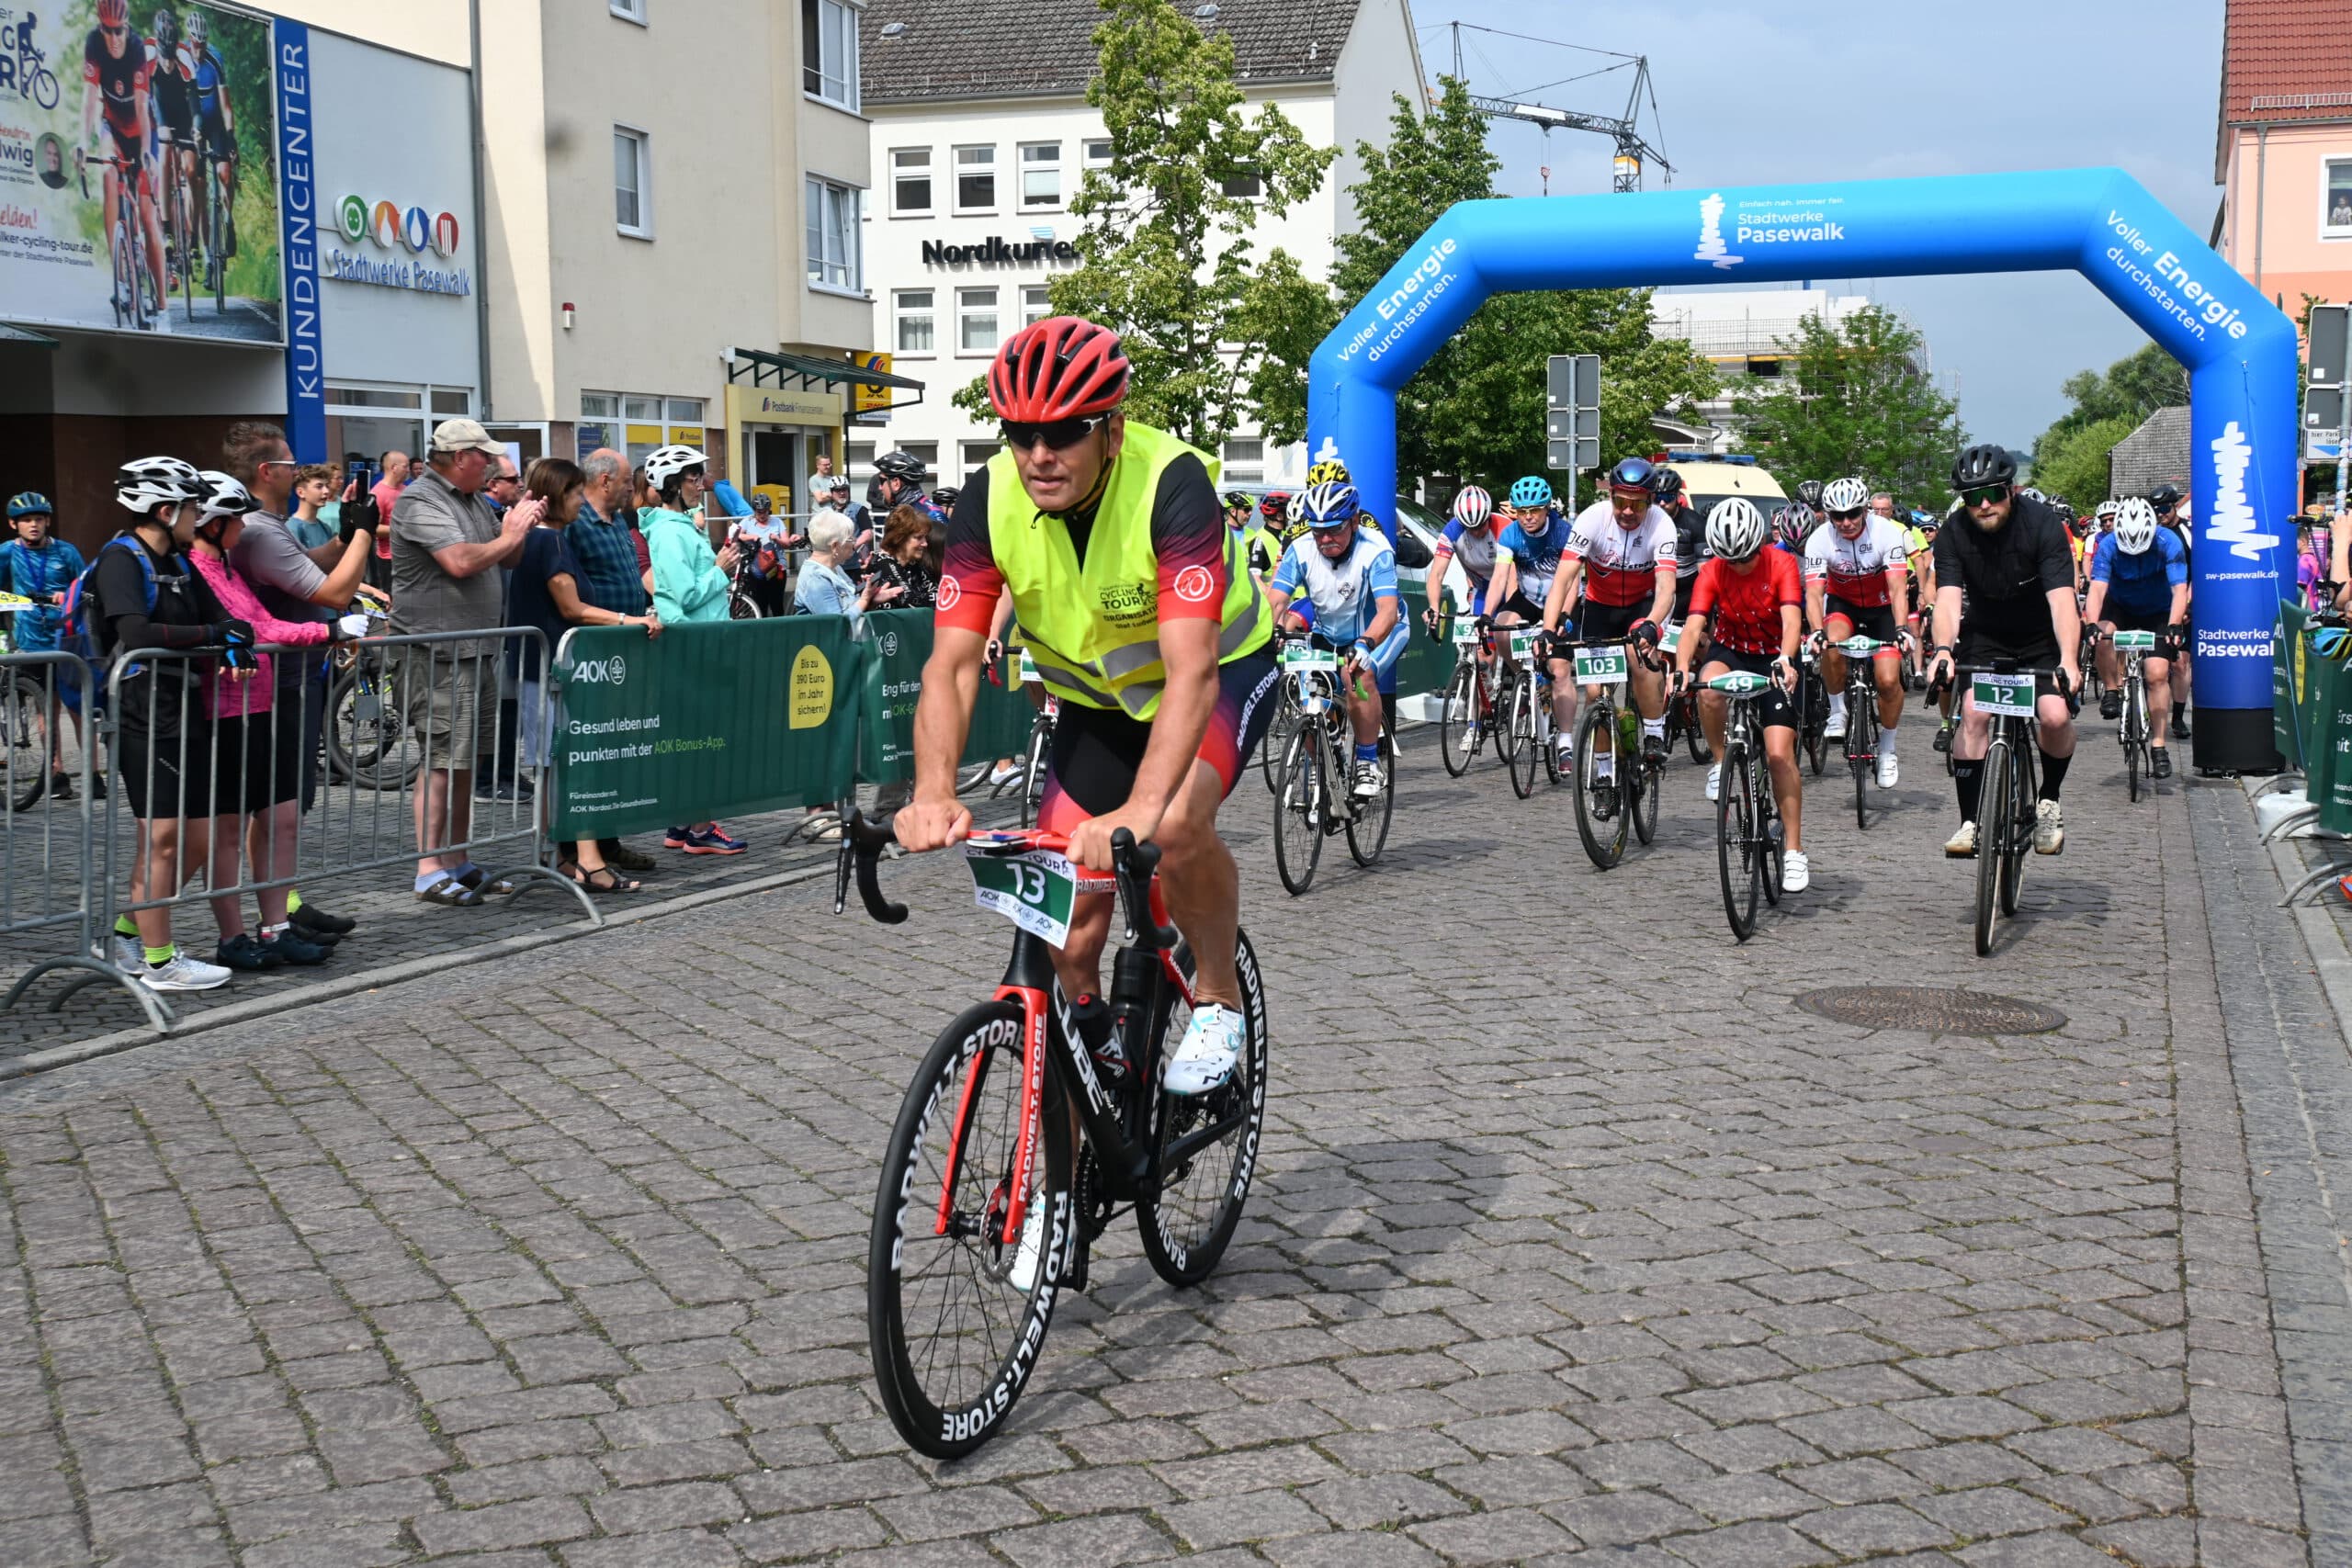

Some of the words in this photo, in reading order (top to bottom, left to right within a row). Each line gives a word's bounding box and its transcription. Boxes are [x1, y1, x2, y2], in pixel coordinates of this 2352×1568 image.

[283, 43, 319, 399] KUNDENCENTER
[1737, 210, 1824, 226] Stadtwerke
[1736, 222, 1846, 244] Pasewalk
[333, 248, 410, 288] Stadtwerke
[412, 260, 471, 297] Pasewalk
[2107, 209, 2154, 257] Voller
[2154, 250, 2248, 340] Energie
[1337, 321, 1380, 362] Voller
[1375, 238, 1457, 321] Energie
[2106, 245, 2206, 342] durchstarten.
[1367, 273, 1458, 363] durchstarten.
[2205, 570, 2279, 581] sw-pasewalk.de
[1100, 588, 1137, 601] CYCLING
[1102, 596, 1141, 610] TOUR
[2198, 628, 2270, 640] Stadtwerke
[2197, 640, 2275, 657] Pasewal
[571, 660, 611, 683] AOK
[800, 659, 809, 669] Bis
[809, 660, 819, 669] zu
[1585, 657, 1617, 674] 103
[808, 673, 825, 683] Euro
[1724, 676, 1753, 693] 49
[797, 689, 807, 699] im
[808, 688, 824, 699] Jahr
[882, 683, 899, 698] Eng
[899, 681, 911, 694] für
[1991, 686, 2015, 705] 12
[797, 703, 827, 716] sichern!
[1236, 666, 1280, 752] RADWELT.STORE
[569, 718, 615, 735] Gesund
[616, 716, 642, 732] leben
[643, 714, 661, 729] und
[569, 748, 619, 766] punkten
[621, 743, 638, 759] mit
[638, 742, 653, 757] der
[654, 739, 674, 755] AOK
[675, 735, 727, 752] Bonus-App.
[570, 805, 588, 813] AOK
[1005, 863, 1046, 905] 13
[979, 890, 1001, 903] AOK
[1035, 917, 1054, 931] AOK
[1052, 972, 1104, 1116] CUBE
[1235, 942, 1266, 1201] RADWELT.STORE
[1018, 1012, 1046, 1203] RADWELT.STORE
[940, 1190, 1069, 1443] RADWELT.STORE
